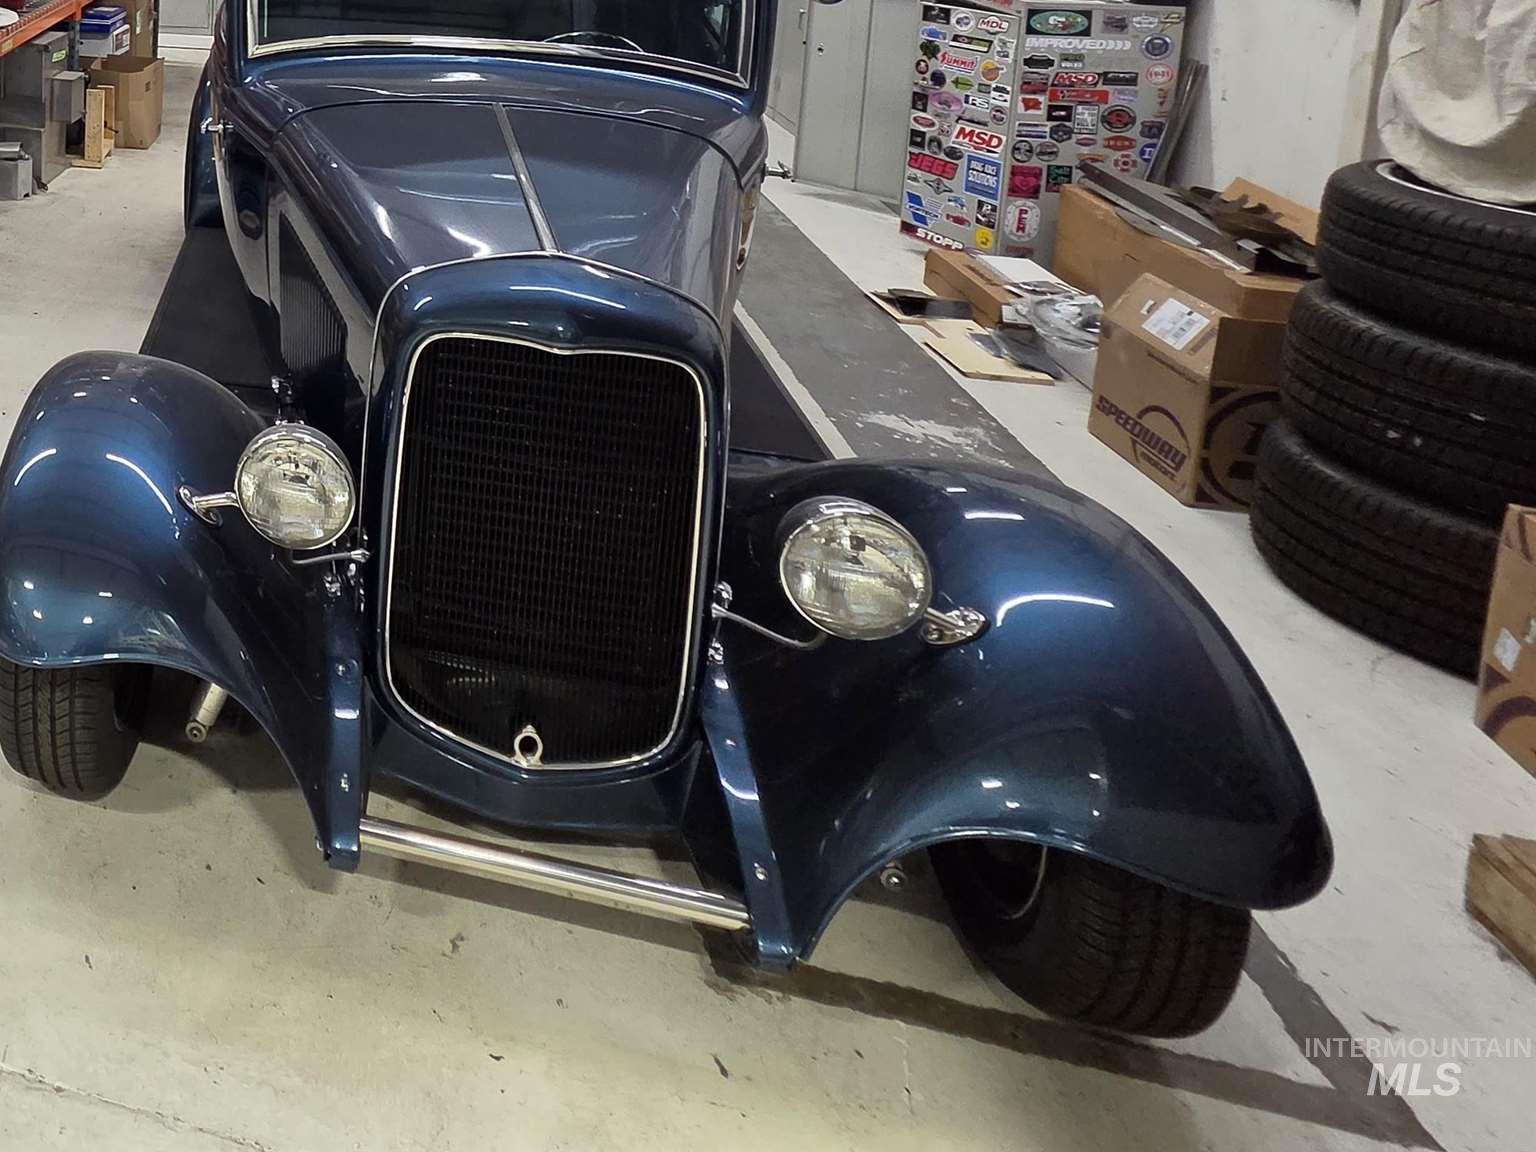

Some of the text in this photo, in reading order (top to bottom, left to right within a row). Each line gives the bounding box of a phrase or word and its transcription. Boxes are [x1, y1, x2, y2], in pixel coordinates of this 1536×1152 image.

[1025, 37, 1107, 50] IMPROVED
[1055, 72, 1099, 85] MSD
[954, 126, 1003, 149] MSD
[1095, 394, 1188, 473] SPEEDWAY
